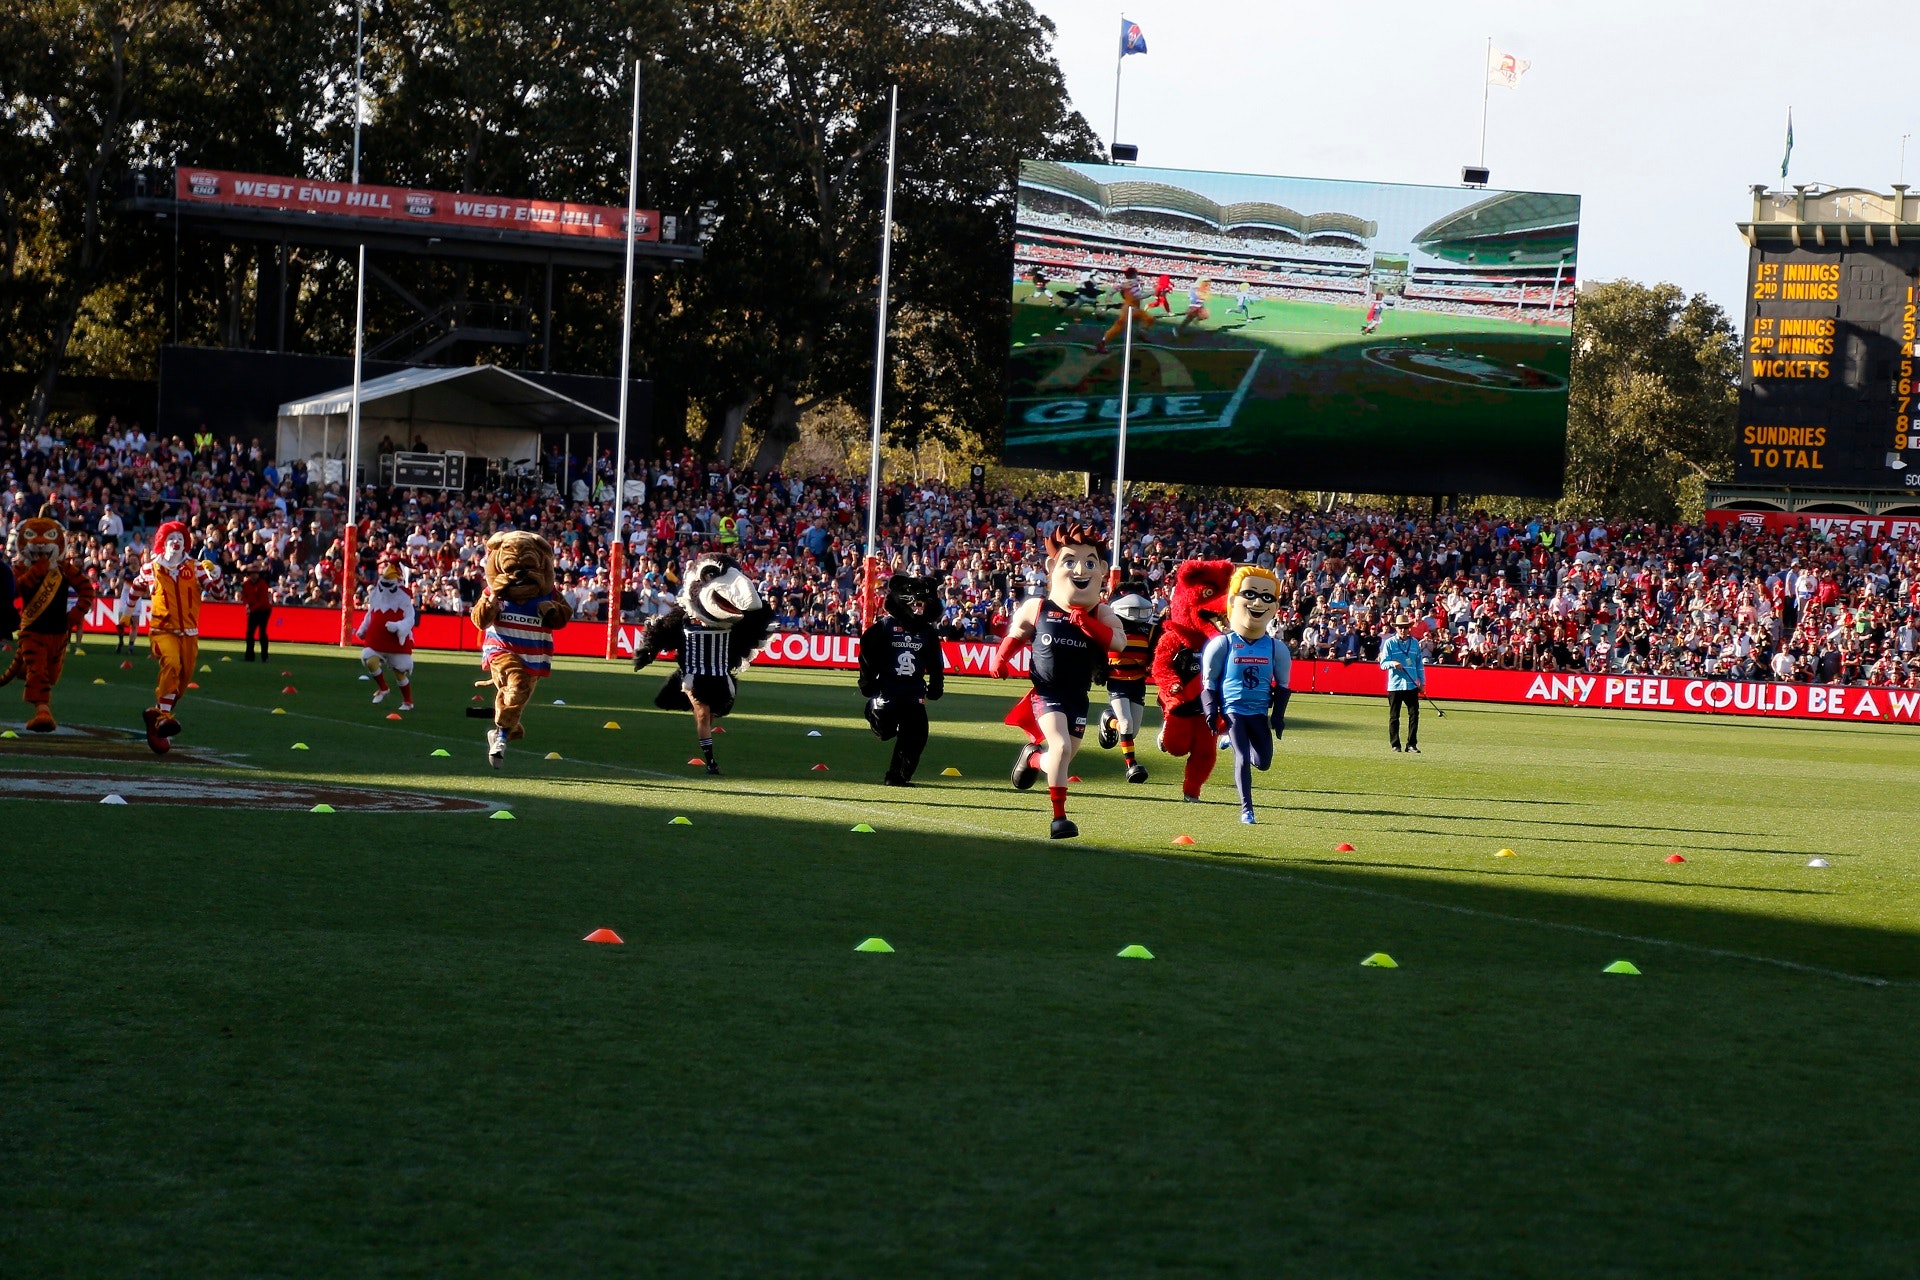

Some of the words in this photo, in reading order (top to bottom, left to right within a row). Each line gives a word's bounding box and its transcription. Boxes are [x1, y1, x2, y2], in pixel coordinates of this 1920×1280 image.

[190, 174, 219, 185] WEST
[235, 180, 294, 199] WEST
[298, 187, 341, 204] END
[346, 191, 391, 209] HILL
[406, 194, 434, 205] WEST
[409, 205, 431, 214] END
[454, 201, 511, 219] WEST
[514, 207, 556, 223] END
[560, 210, 604, 228] HILL
[622, 214, 648, 224] WST
[1757, 264, 1779, 281] 1ST
[1783, 264, 1840, 281] INNINGS
[1753, 283, 1778, 299] 2ND
[1782, 283, 1838, 300] INNINGS
[1907, 286, 1914, 303] 1
[1903, 304, 1917, 322] 2
[1754, 319, 1774, 335] 1ST
[1779, 319, 1836, 336] INNINGS
[1902, 323, 1915, 340] 3
[1750, 336, 1774, 354] 2ND
[1777, 338, 1834, 355] INNINGS
[1901, 341, 1914, 358] 4
[1752, 359, 1830, 379] WICKETS
[1900, 360, 1912, 377] 5
[1898, 378, 1911, 395] 6
[1024, 396, 1205, 424] GUE
[1898, 396, 1911, 413] 7
[1896, 415, 1909, 433] 8
[1743, 425, 1826, 447] SUNDRIES
[1894, 433, 1908, 450] 9
[1750, 448, 1824, 469] TOTAL
[500, 614, 540, 625] HOLDEN
[764, 632, 860, 663] COULD
[1053, 637, 1087, 648] VEOLIA
[1525, 674, 1596, 702] ANY
[1605, 678, 1674, 705] PEEL
[1684, 681, 1797, 711] COULD
[1808, 687, 1845, 714] BE
[1853, 691, 1880, 717] A
